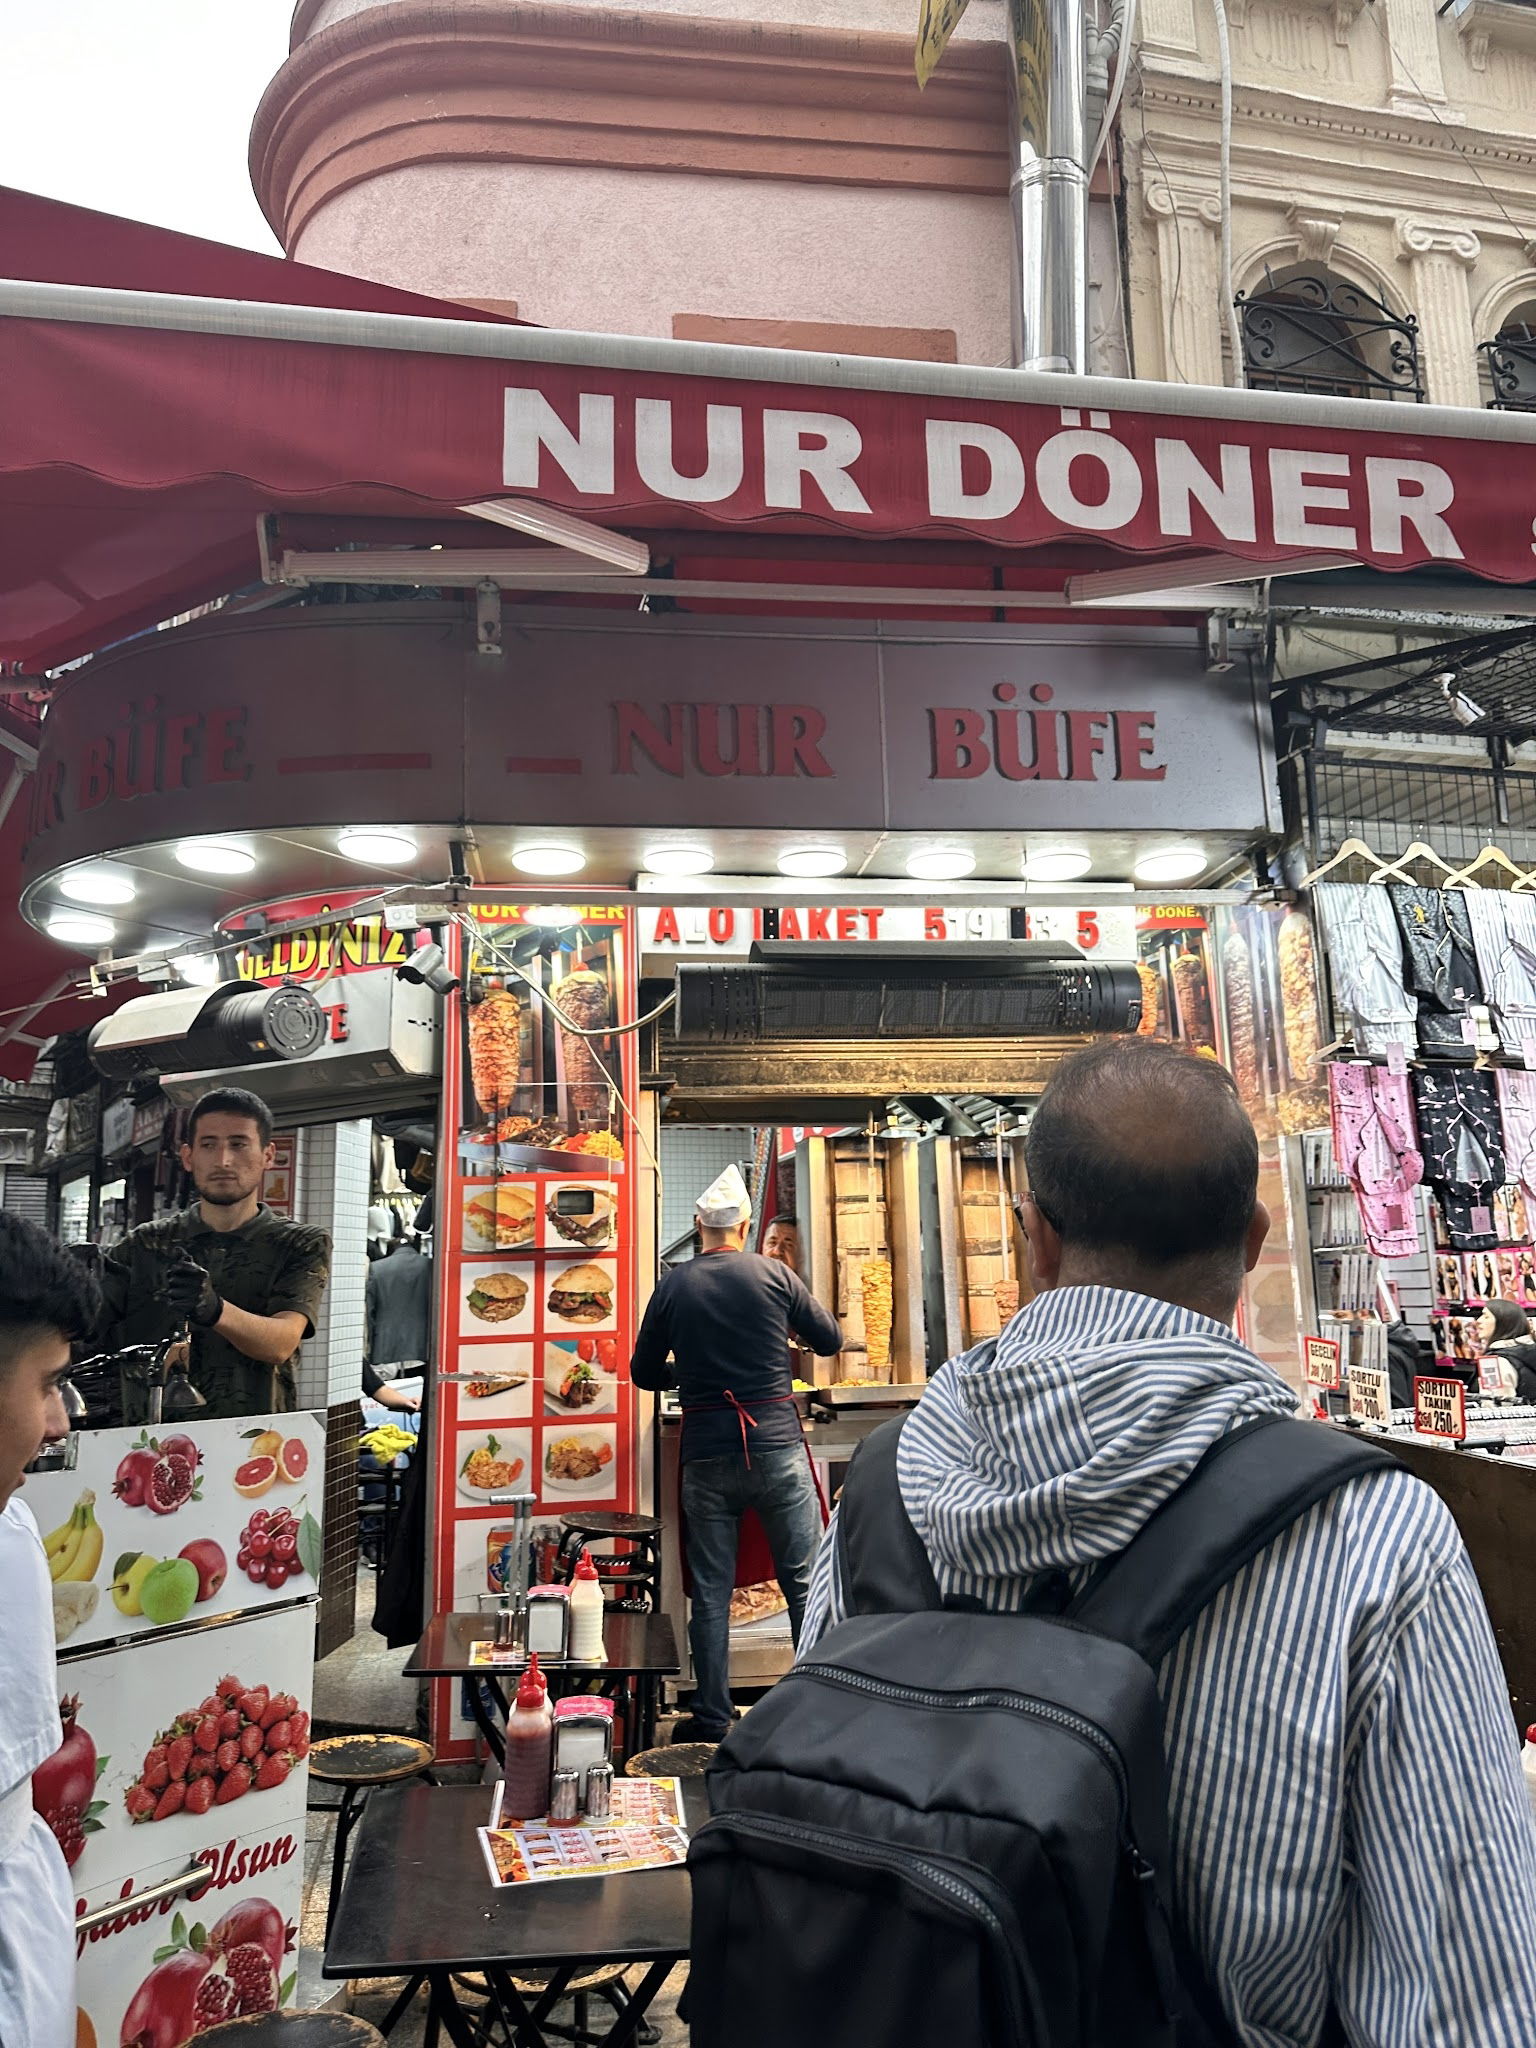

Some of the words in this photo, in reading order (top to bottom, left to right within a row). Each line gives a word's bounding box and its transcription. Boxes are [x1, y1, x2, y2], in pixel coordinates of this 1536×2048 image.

[502, 386, 873, 514] NUR
[925, 406, 1466, 560] DÖNER
[77, 694, 254, 813] BÜFE
[610, 703, 834, 779] NUR
[927, 682, 1167, 782] BÜFE
[1423, 1396, 1452, 1411] TAKIM
